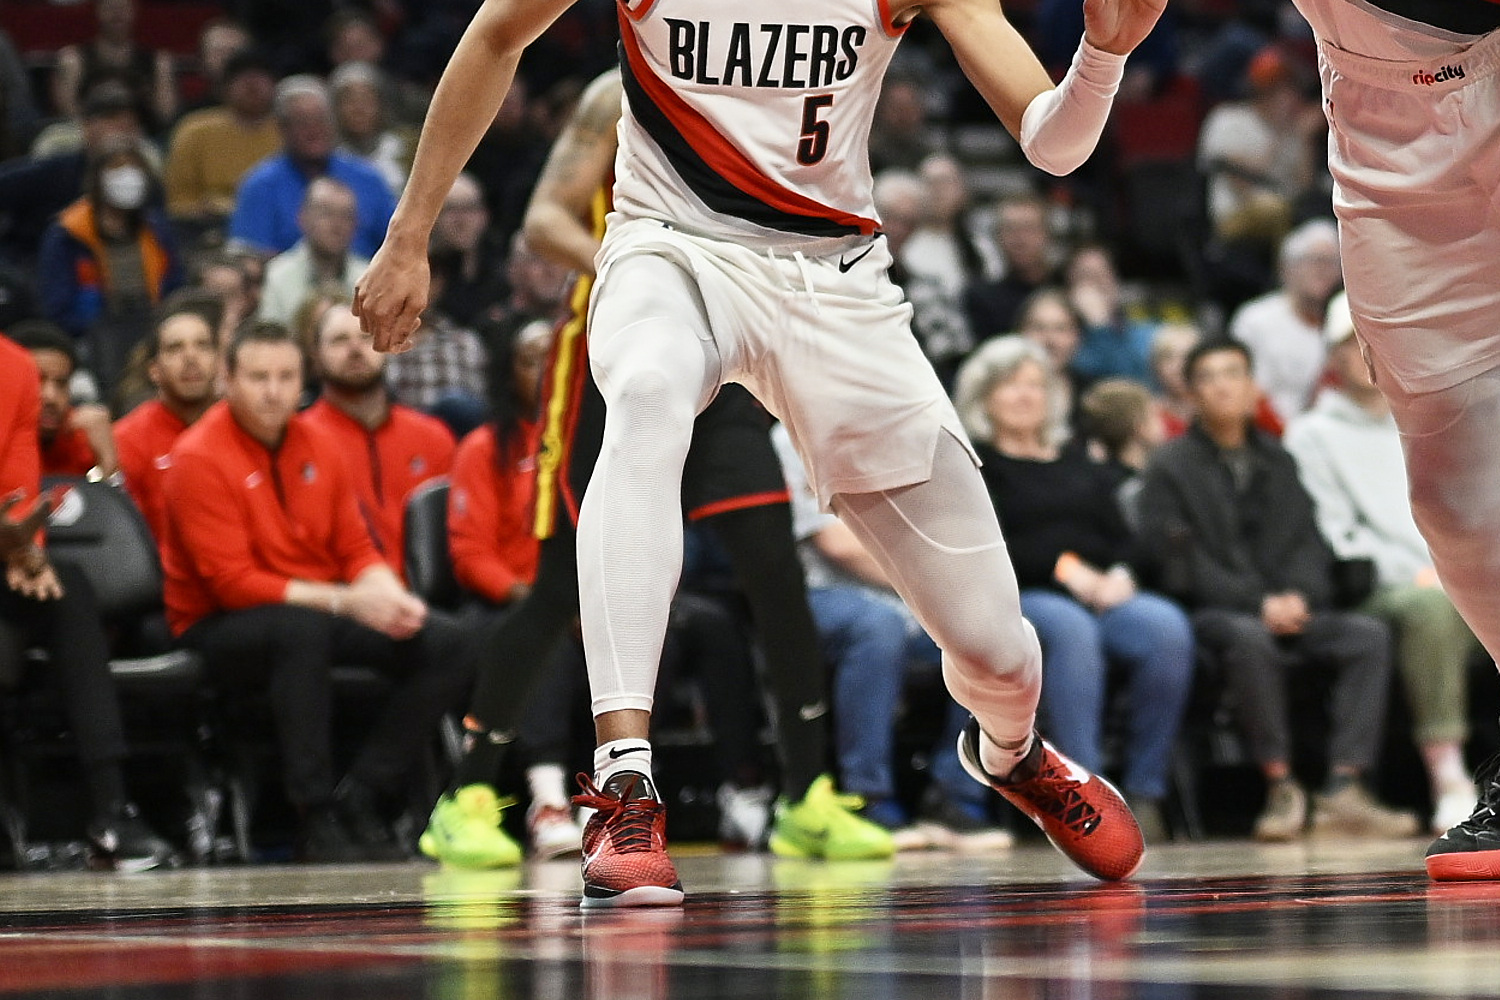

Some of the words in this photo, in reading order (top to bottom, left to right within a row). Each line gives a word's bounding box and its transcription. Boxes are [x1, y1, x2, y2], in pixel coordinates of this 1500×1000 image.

[663, 18, 867, 88] BLAZERS
[1412, 64, 1466, 86] ripcity
[796, 94, 834, 167] 5
